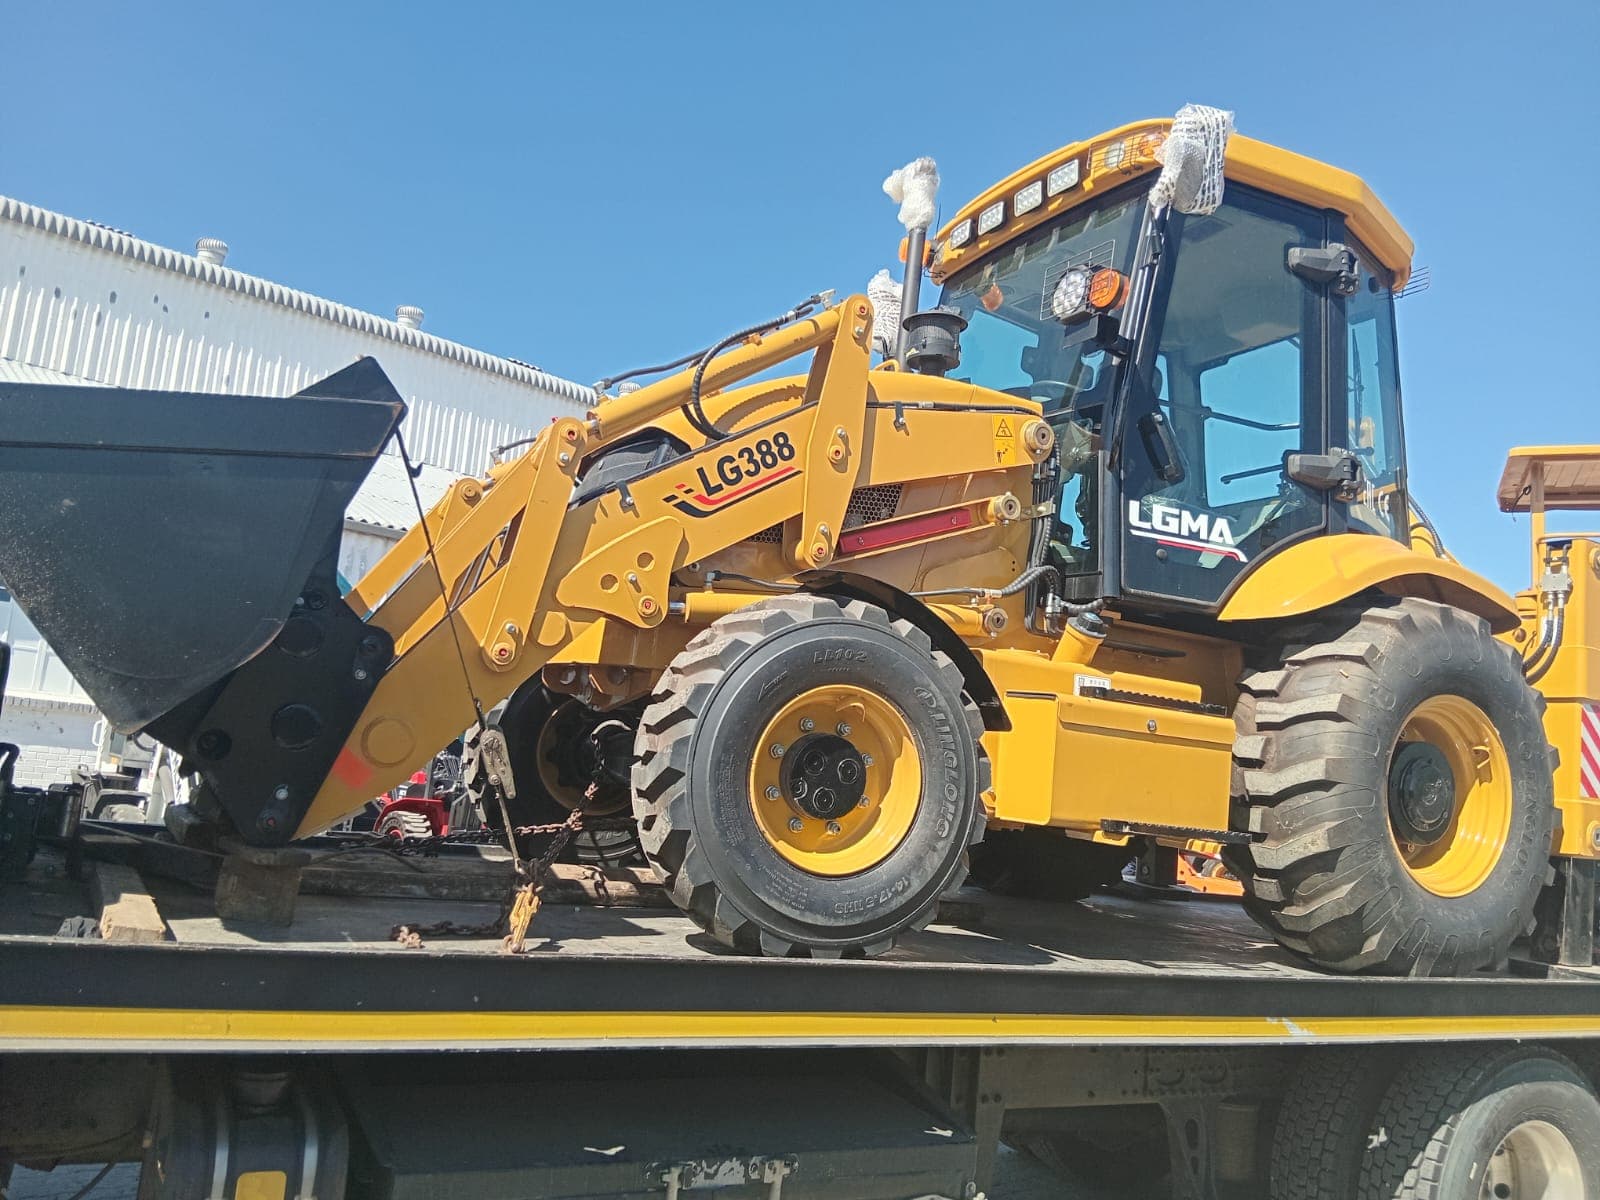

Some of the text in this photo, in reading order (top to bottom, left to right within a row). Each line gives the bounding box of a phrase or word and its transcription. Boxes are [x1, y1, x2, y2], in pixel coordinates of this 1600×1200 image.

[696, 432, 795, 496] LG388
[1128, 500, 1236, 545] LGMA
[930, 711, 958, 838] LINGLONG
